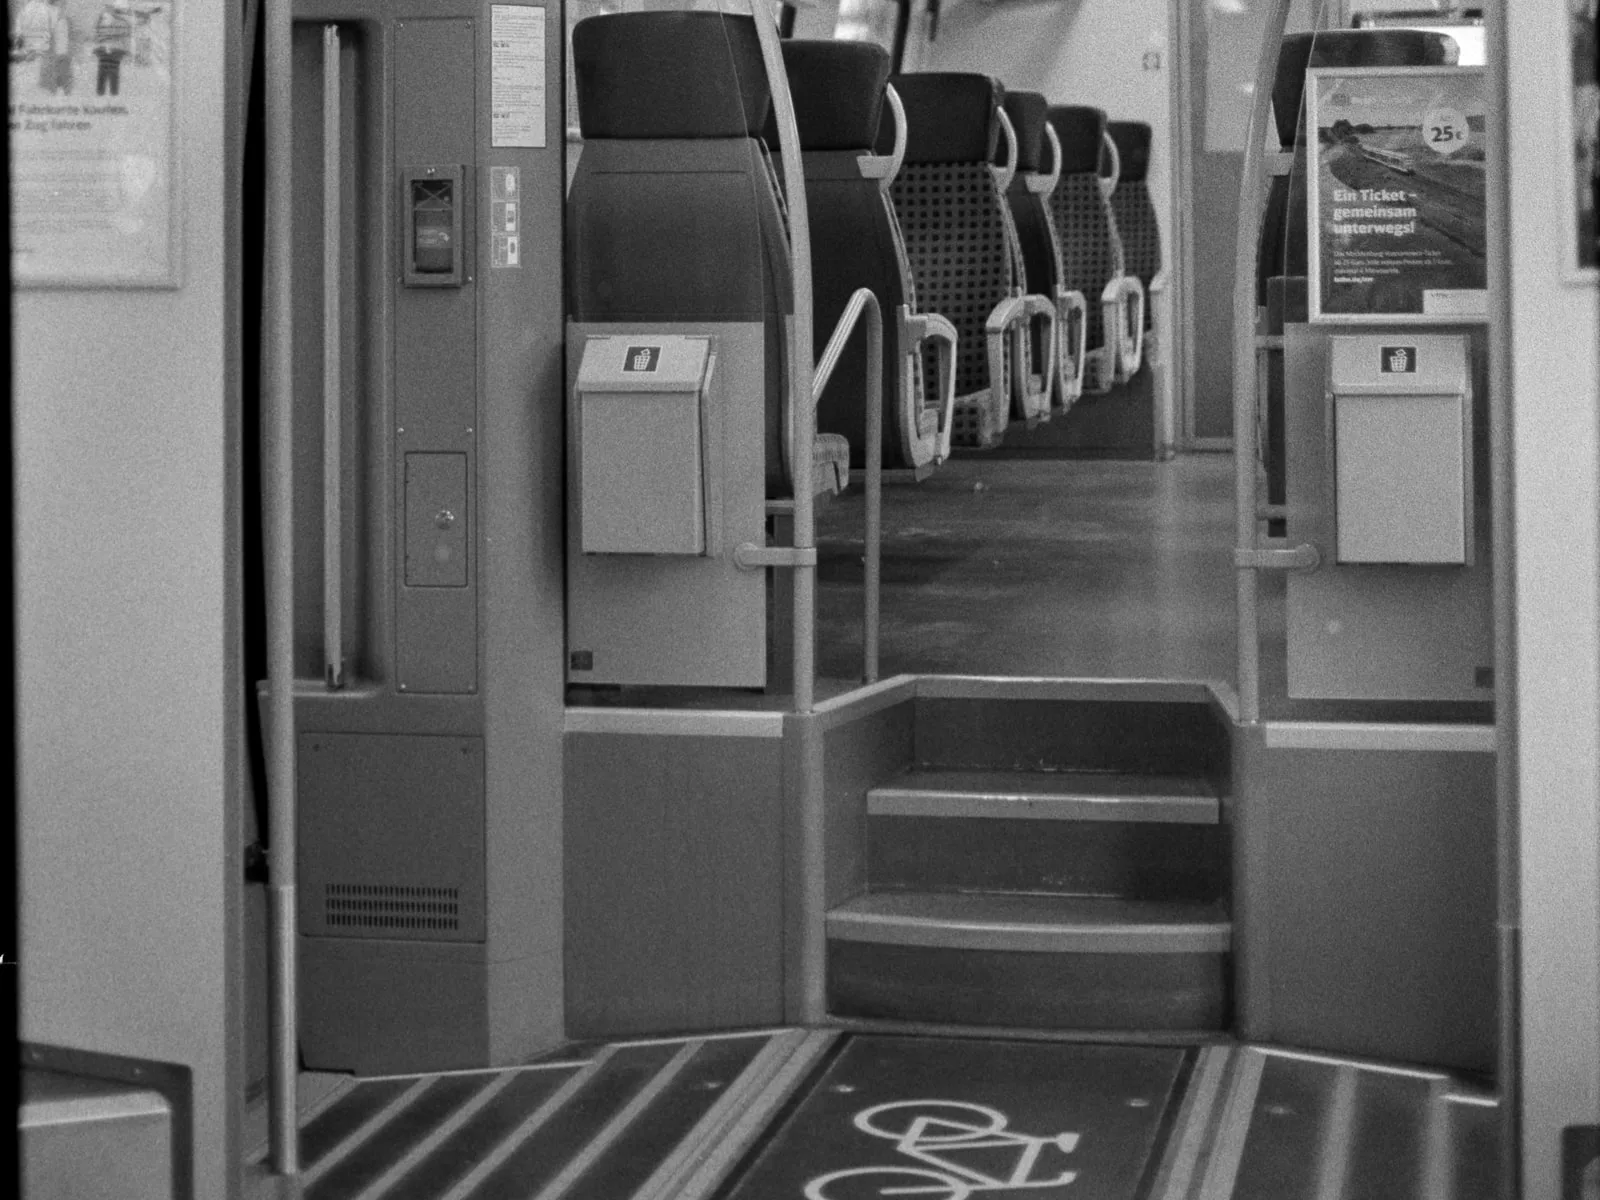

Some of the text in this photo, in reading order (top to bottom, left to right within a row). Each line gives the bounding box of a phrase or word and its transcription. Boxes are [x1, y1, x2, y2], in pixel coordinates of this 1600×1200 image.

[1333, 188, 1357, 201] Ein
[1360, 188, 1406, 201] Ticket
[1333, 205, 1417, 221] gemeinsam
[1333, 221, 1415, 236] unterwegs!
